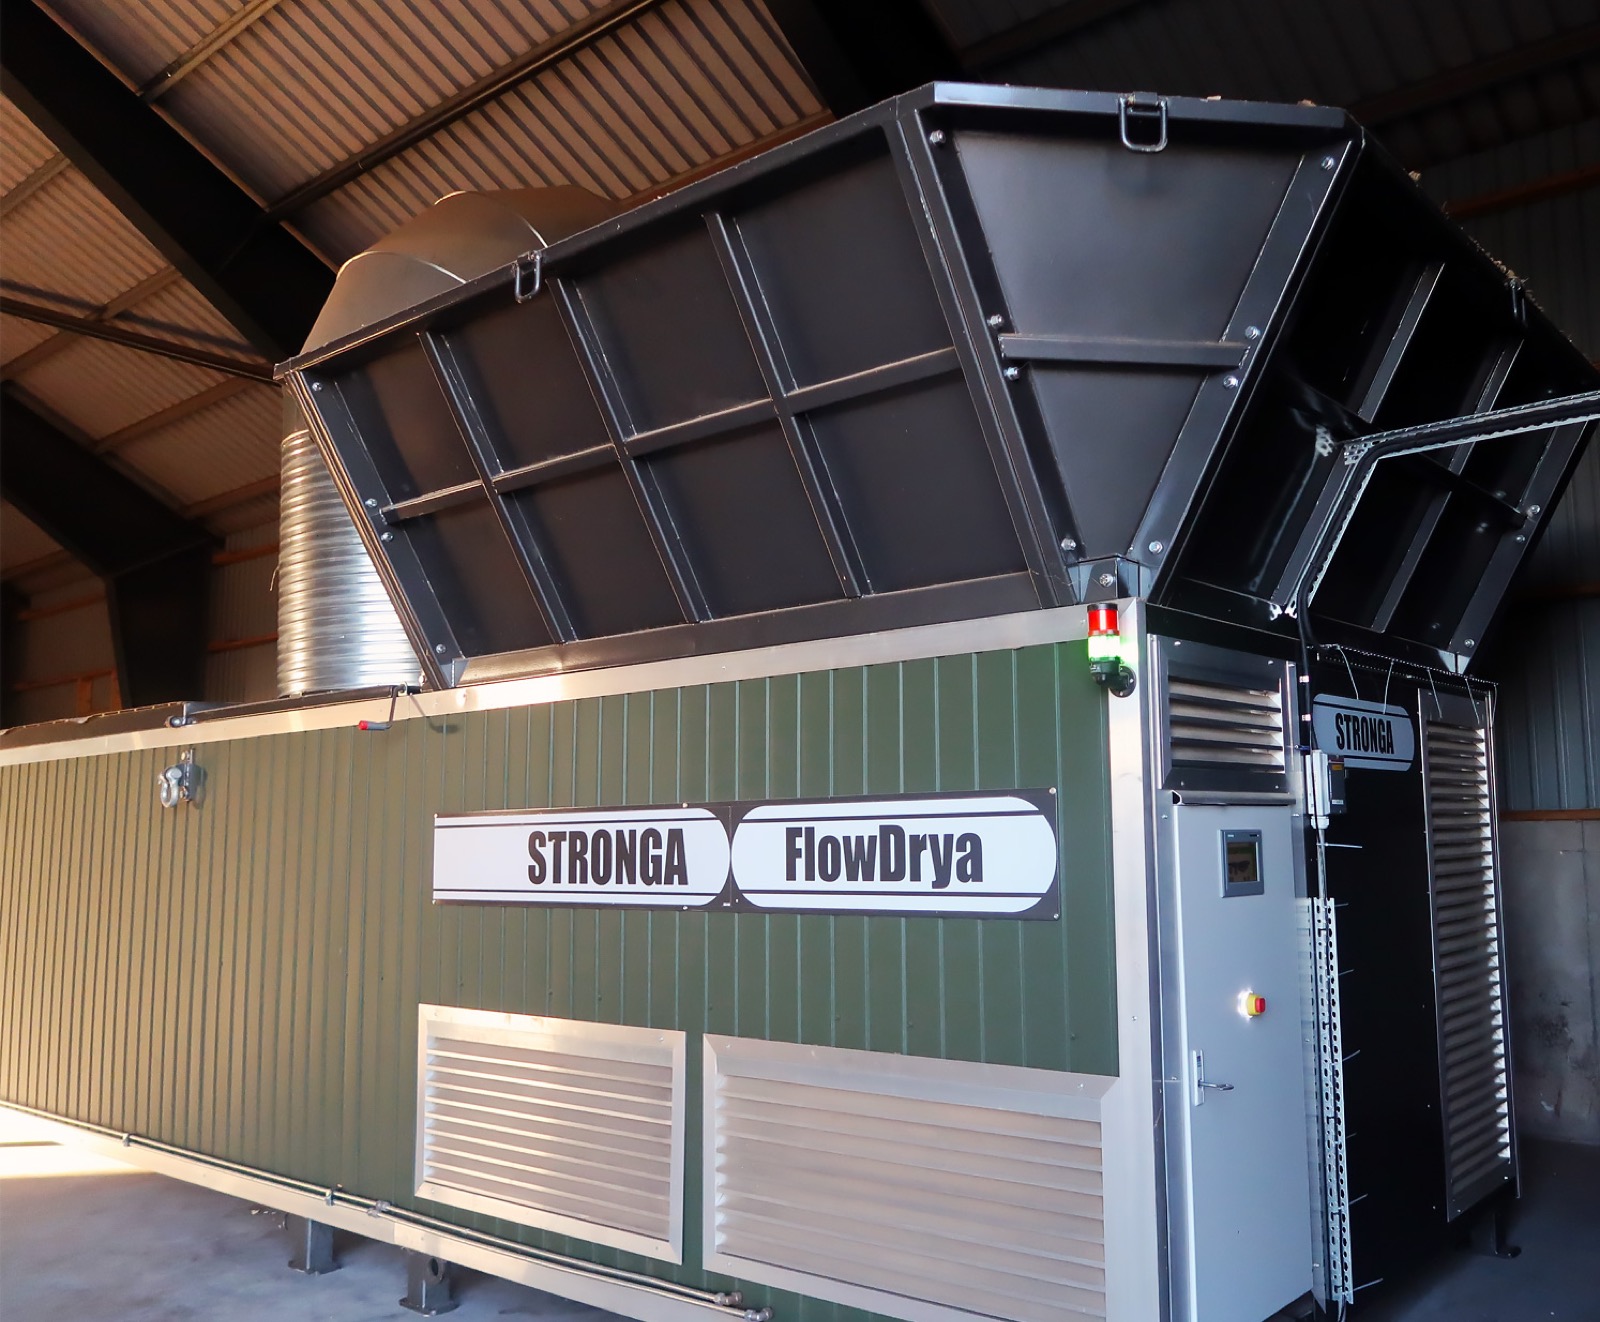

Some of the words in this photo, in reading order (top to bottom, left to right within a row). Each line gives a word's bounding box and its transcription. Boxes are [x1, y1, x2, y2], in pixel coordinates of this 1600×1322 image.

[1335, 713, 1394, 754] STRONGA
[528, 828, 688, 885] STRONGA
[785, 825, 983, 889] FlowDrya
